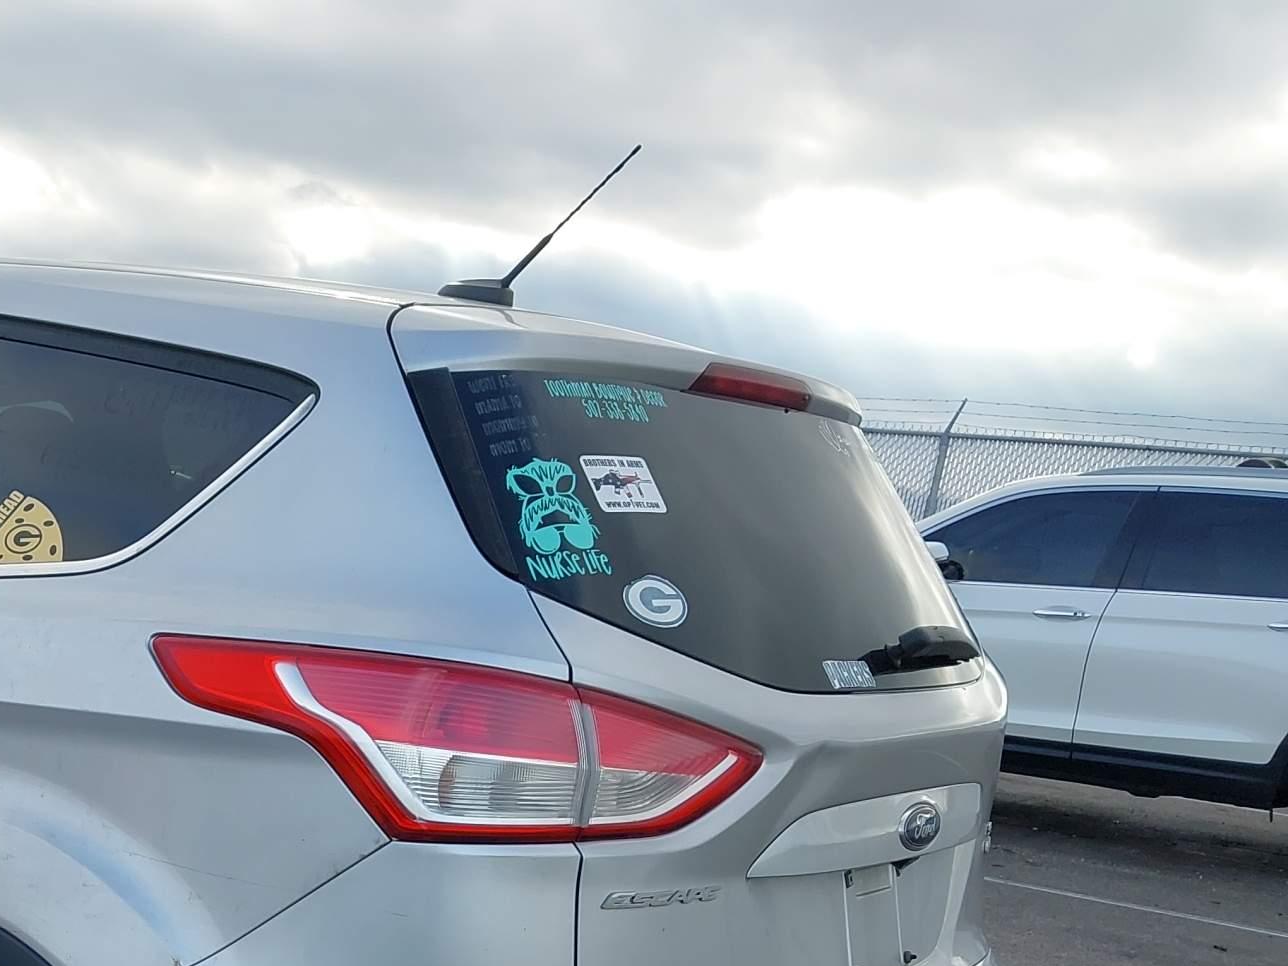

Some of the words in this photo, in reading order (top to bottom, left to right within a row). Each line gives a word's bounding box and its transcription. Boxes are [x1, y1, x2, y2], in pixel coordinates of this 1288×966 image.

[582, 459, 617, 467] BROTHERS
[617, 459, 626, 468] IN
[626, 459, 645, 469] ARMS
